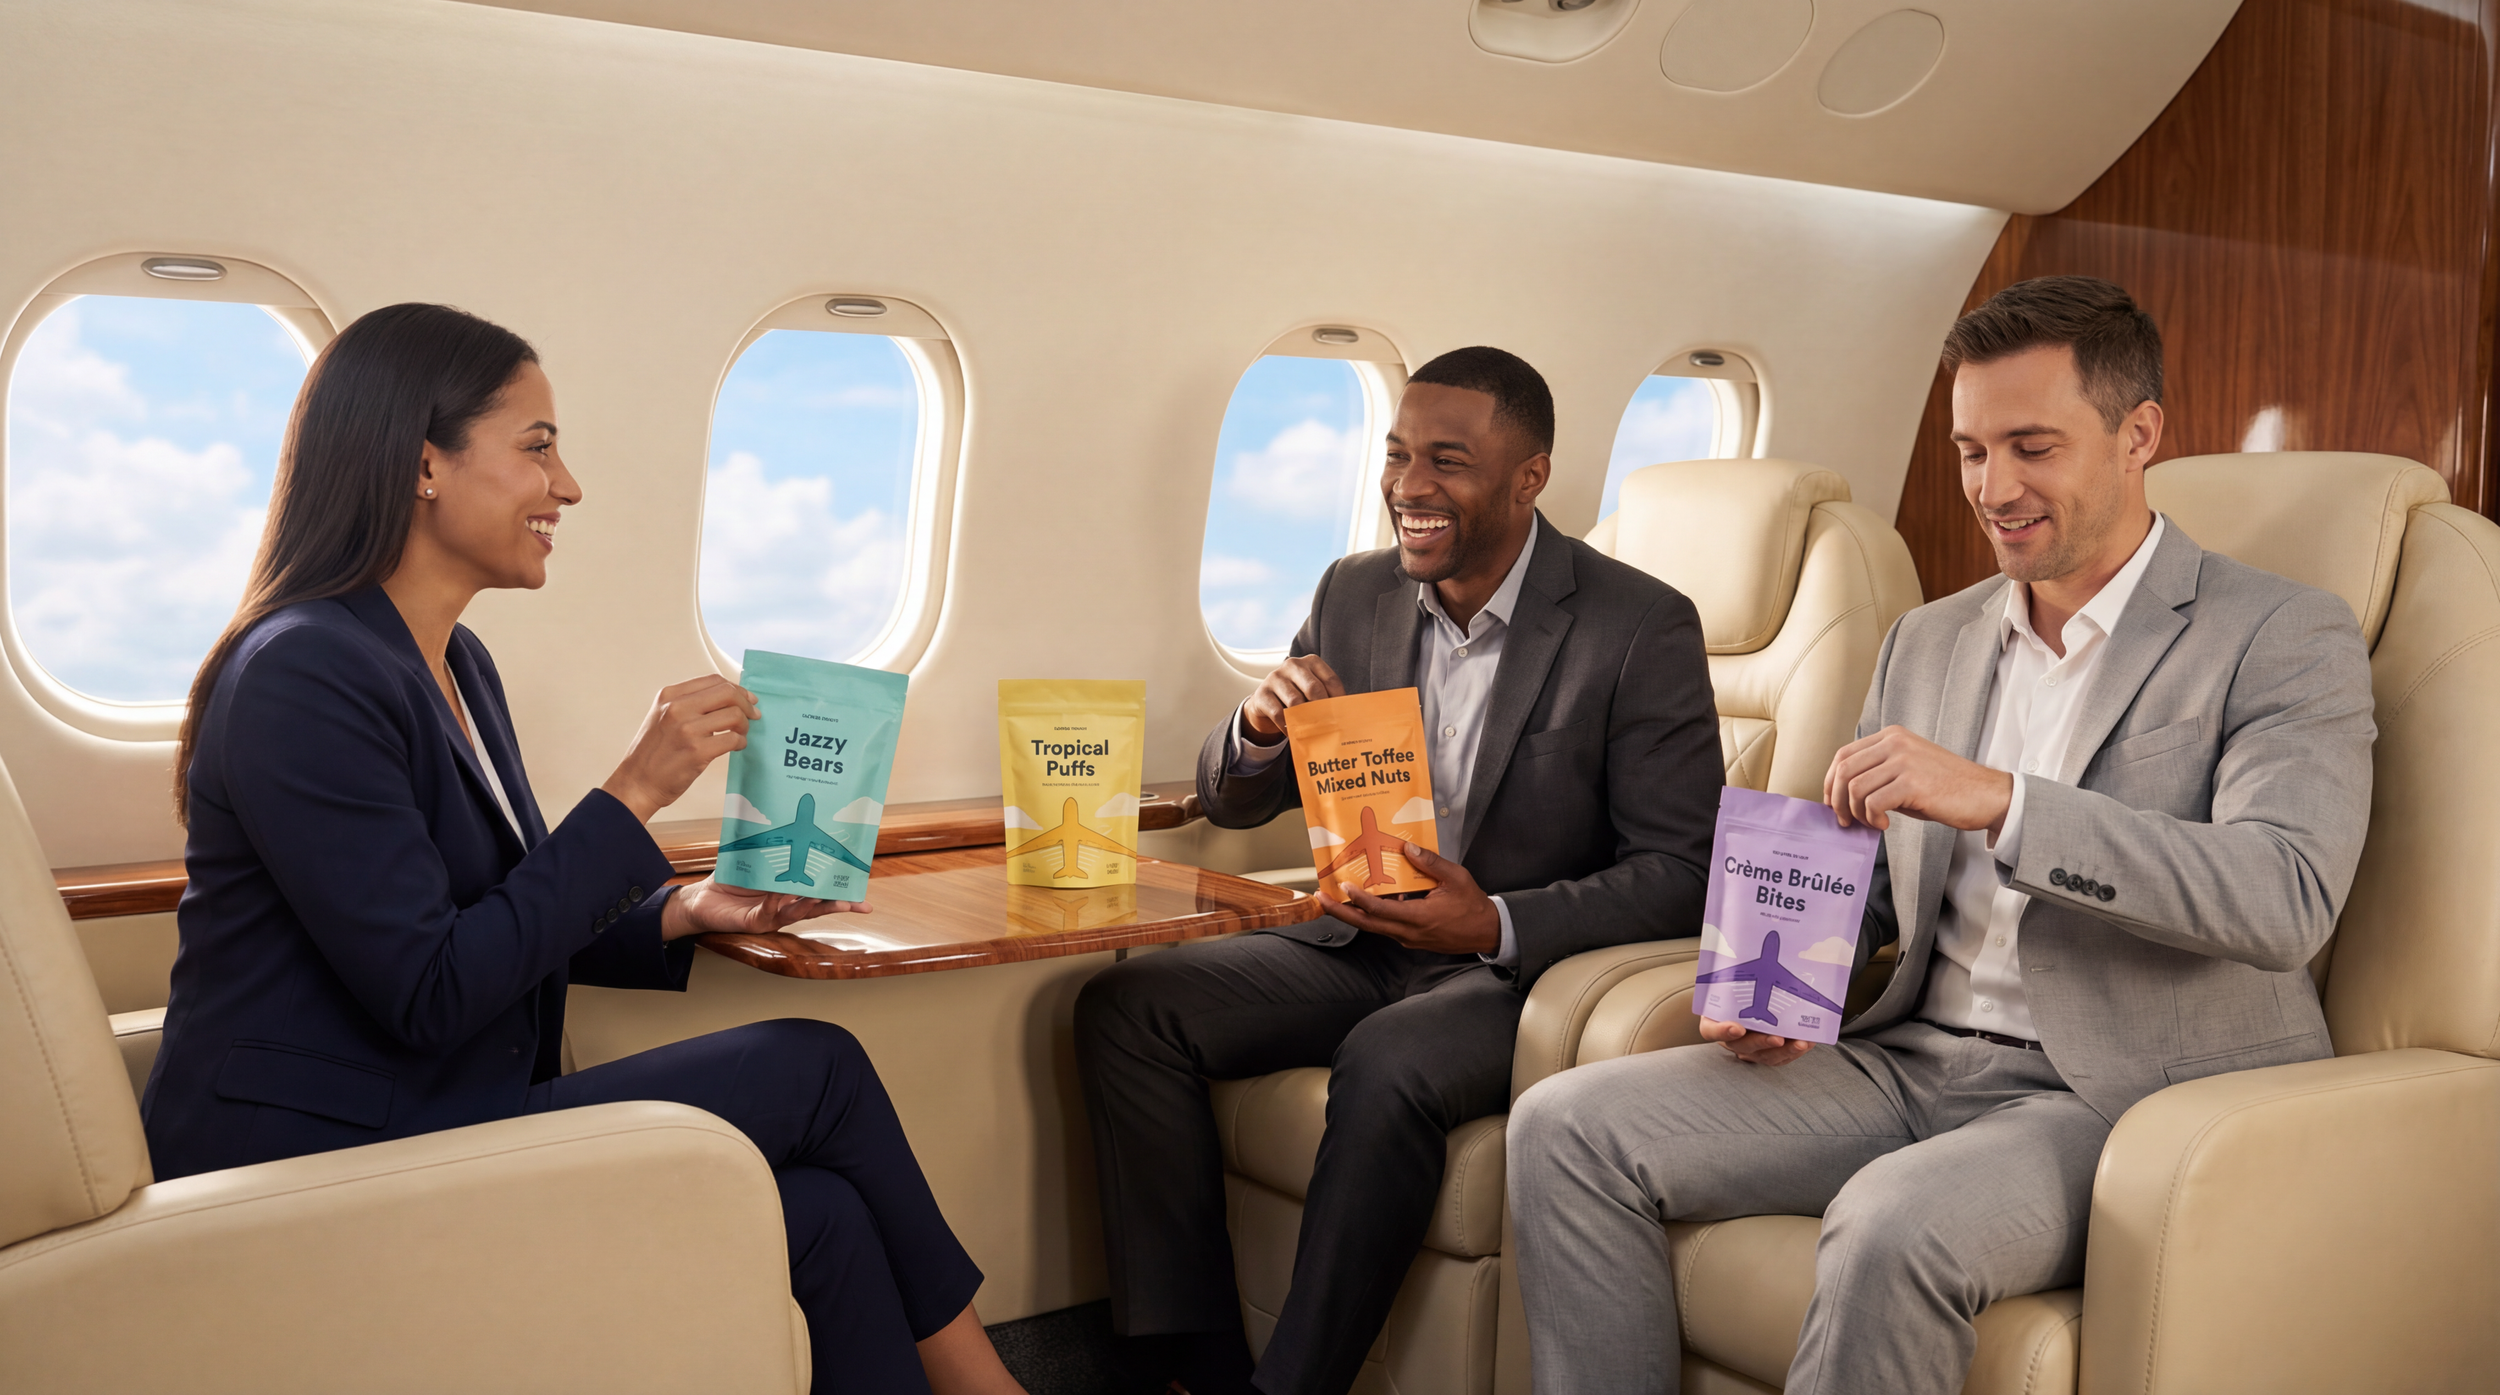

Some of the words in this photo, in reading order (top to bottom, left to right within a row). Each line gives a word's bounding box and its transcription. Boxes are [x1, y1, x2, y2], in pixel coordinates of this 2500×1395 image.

[785, 727, 848, 755] Jazzy
[1031, 739, 1109, 759] Tropical
[783, 748, 844, 774] Bears
[1046, 760, 1095, 777] Puffs
[1307, 757, 1358, 777] Butter
[1361, 748, 1415, 767] Toffee
[1316, 772, 1367, 795] Mixed
[1371, 769, 1411, 786] Nuts
[1724, 856, 1783, 884] Crème
[1788, 868, 1856, 897] Brûlée
[1755, 885, 1806, 912] Bites
